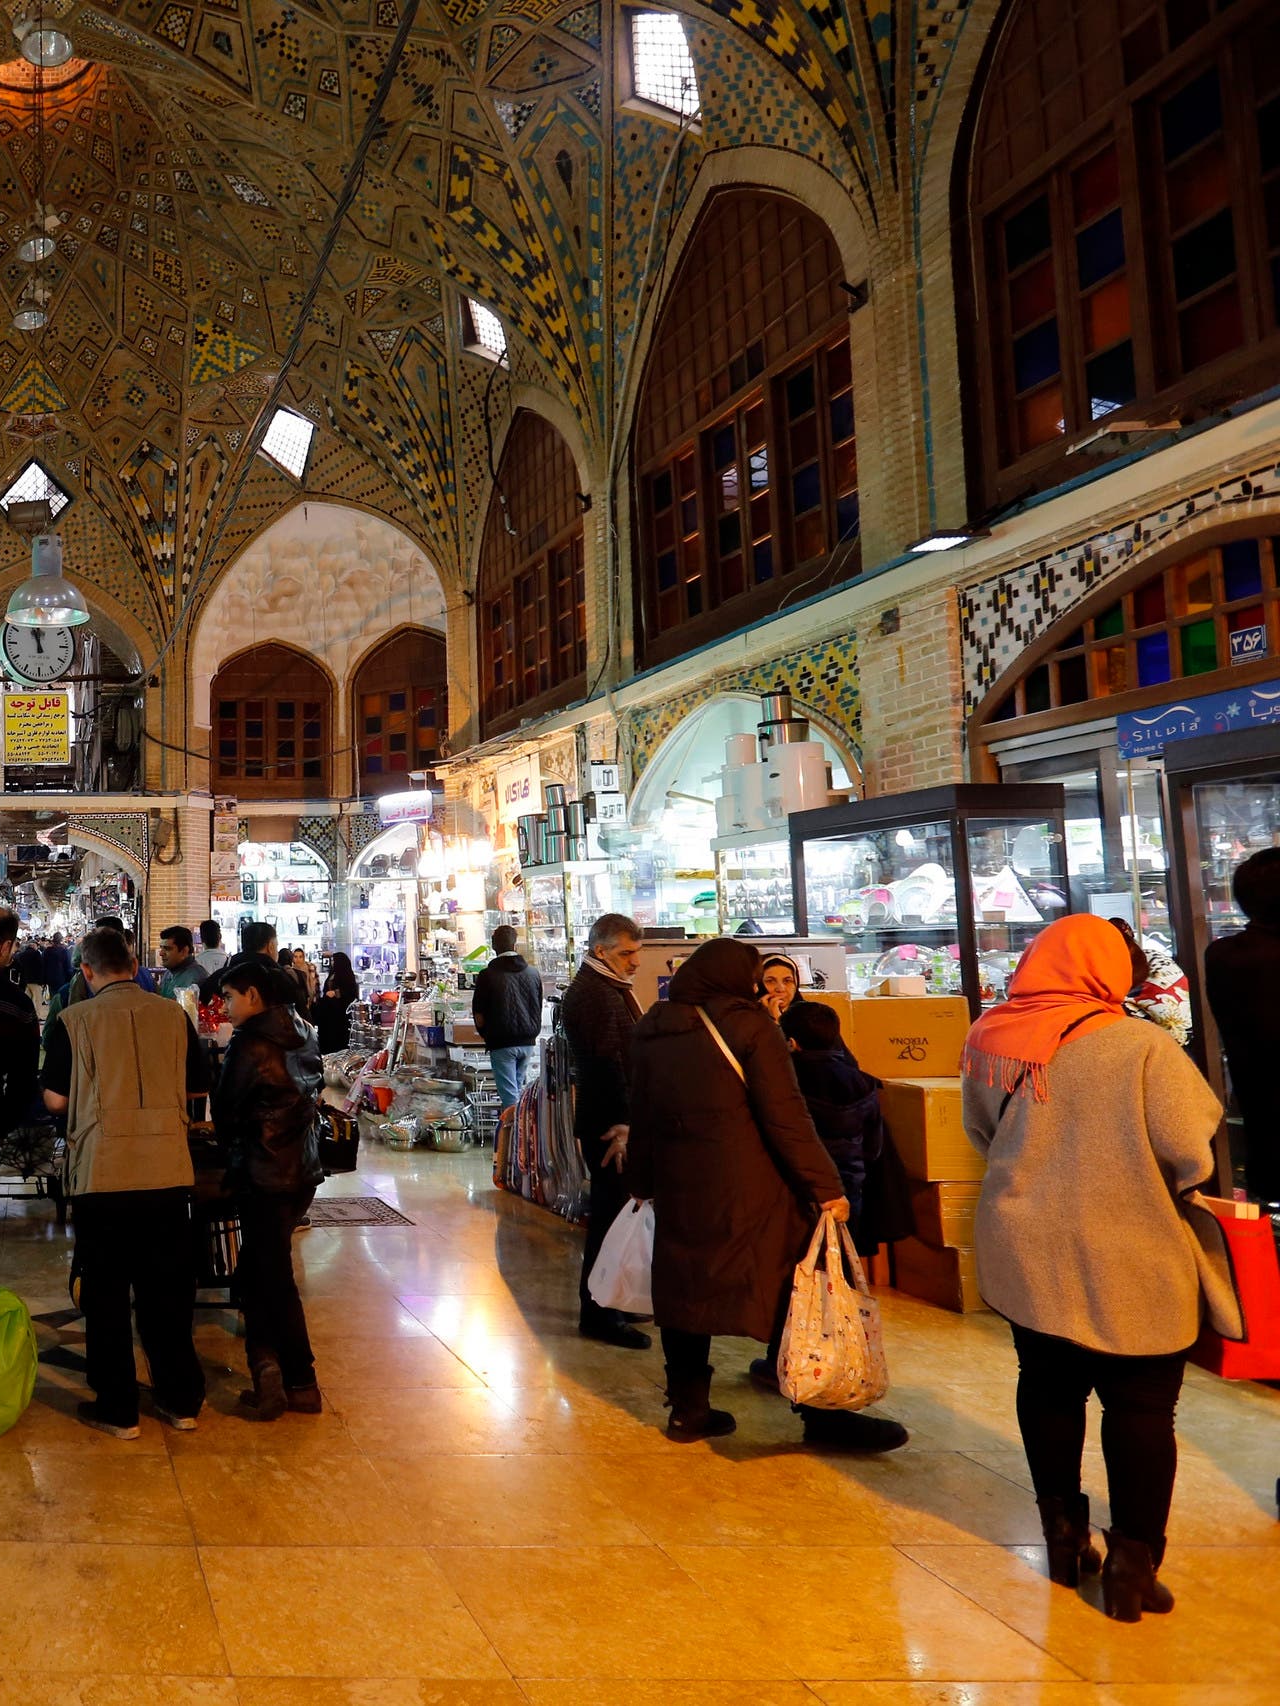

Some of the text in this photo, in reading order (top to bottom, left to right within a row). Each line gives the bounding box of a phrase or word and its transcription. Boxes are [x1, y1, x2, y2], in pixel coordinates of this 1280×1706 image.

[1232, 632, 1262, 652] ۳۵۶
[10, 696, 61, 711] قابل توجه
[888, 1037, 929, 1046] VERONA
